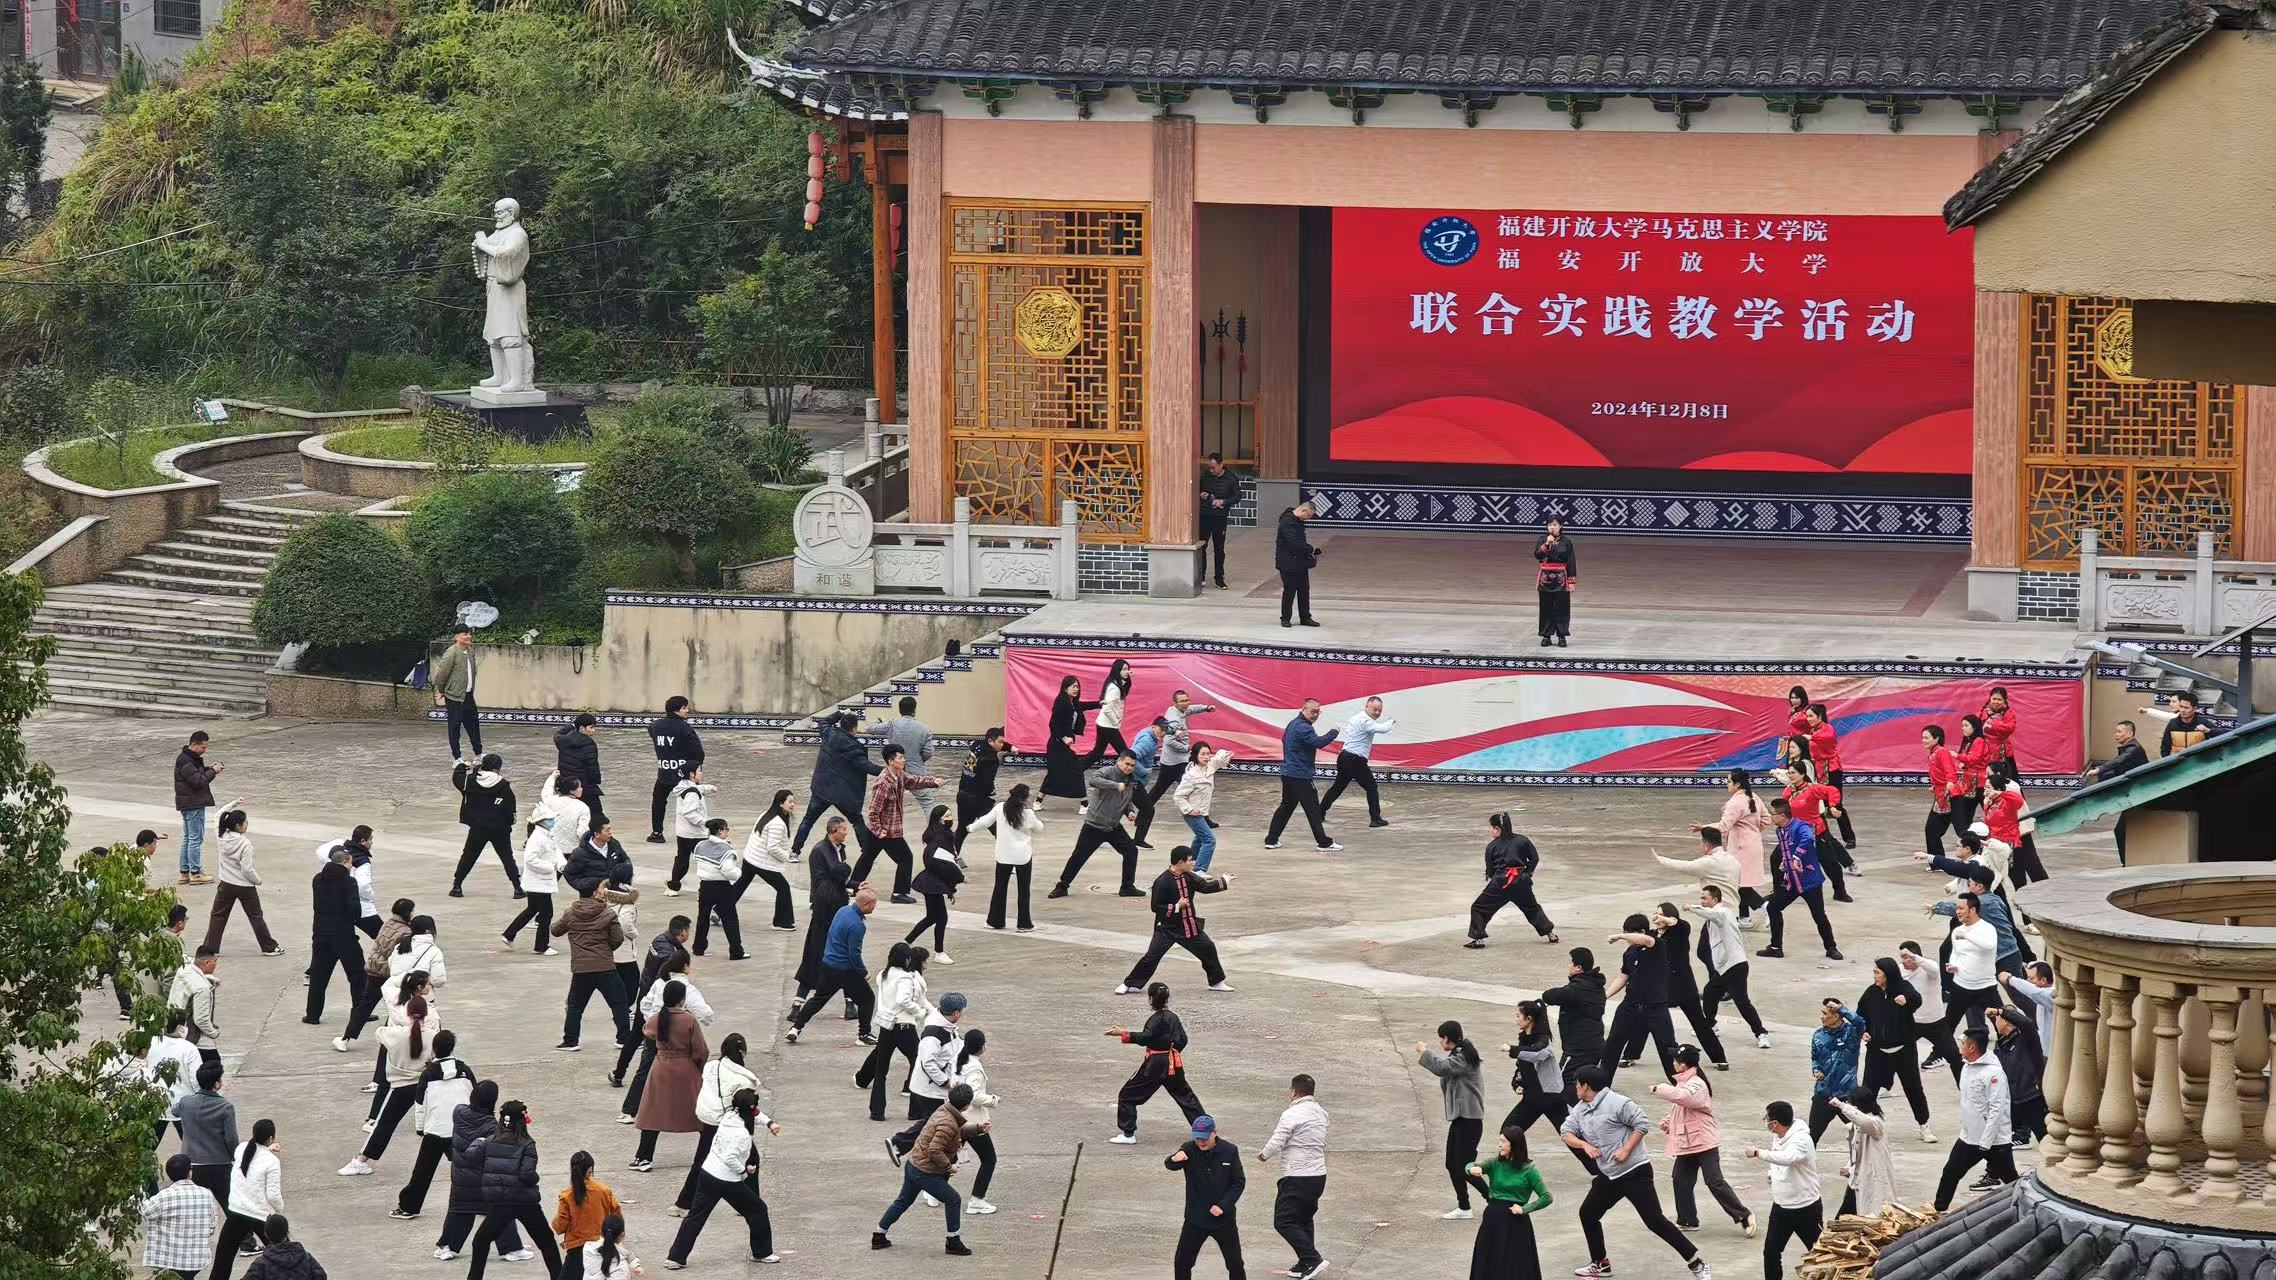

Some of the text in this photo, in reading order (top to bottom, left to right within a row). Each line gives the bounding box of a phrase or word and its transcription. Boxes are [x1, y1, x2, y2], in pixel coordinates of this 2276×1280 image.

[1497, 214, 1828, 241] 福建开放大学马克思主义学院
[1497, 248, 1828, 275] 福安开放大学
[1409, 291, 1916, 343] 联合实践教学活动
[1591, 401, 1729, 419] 2024年12月8日
[816, 572, 852, 586] 和谐
